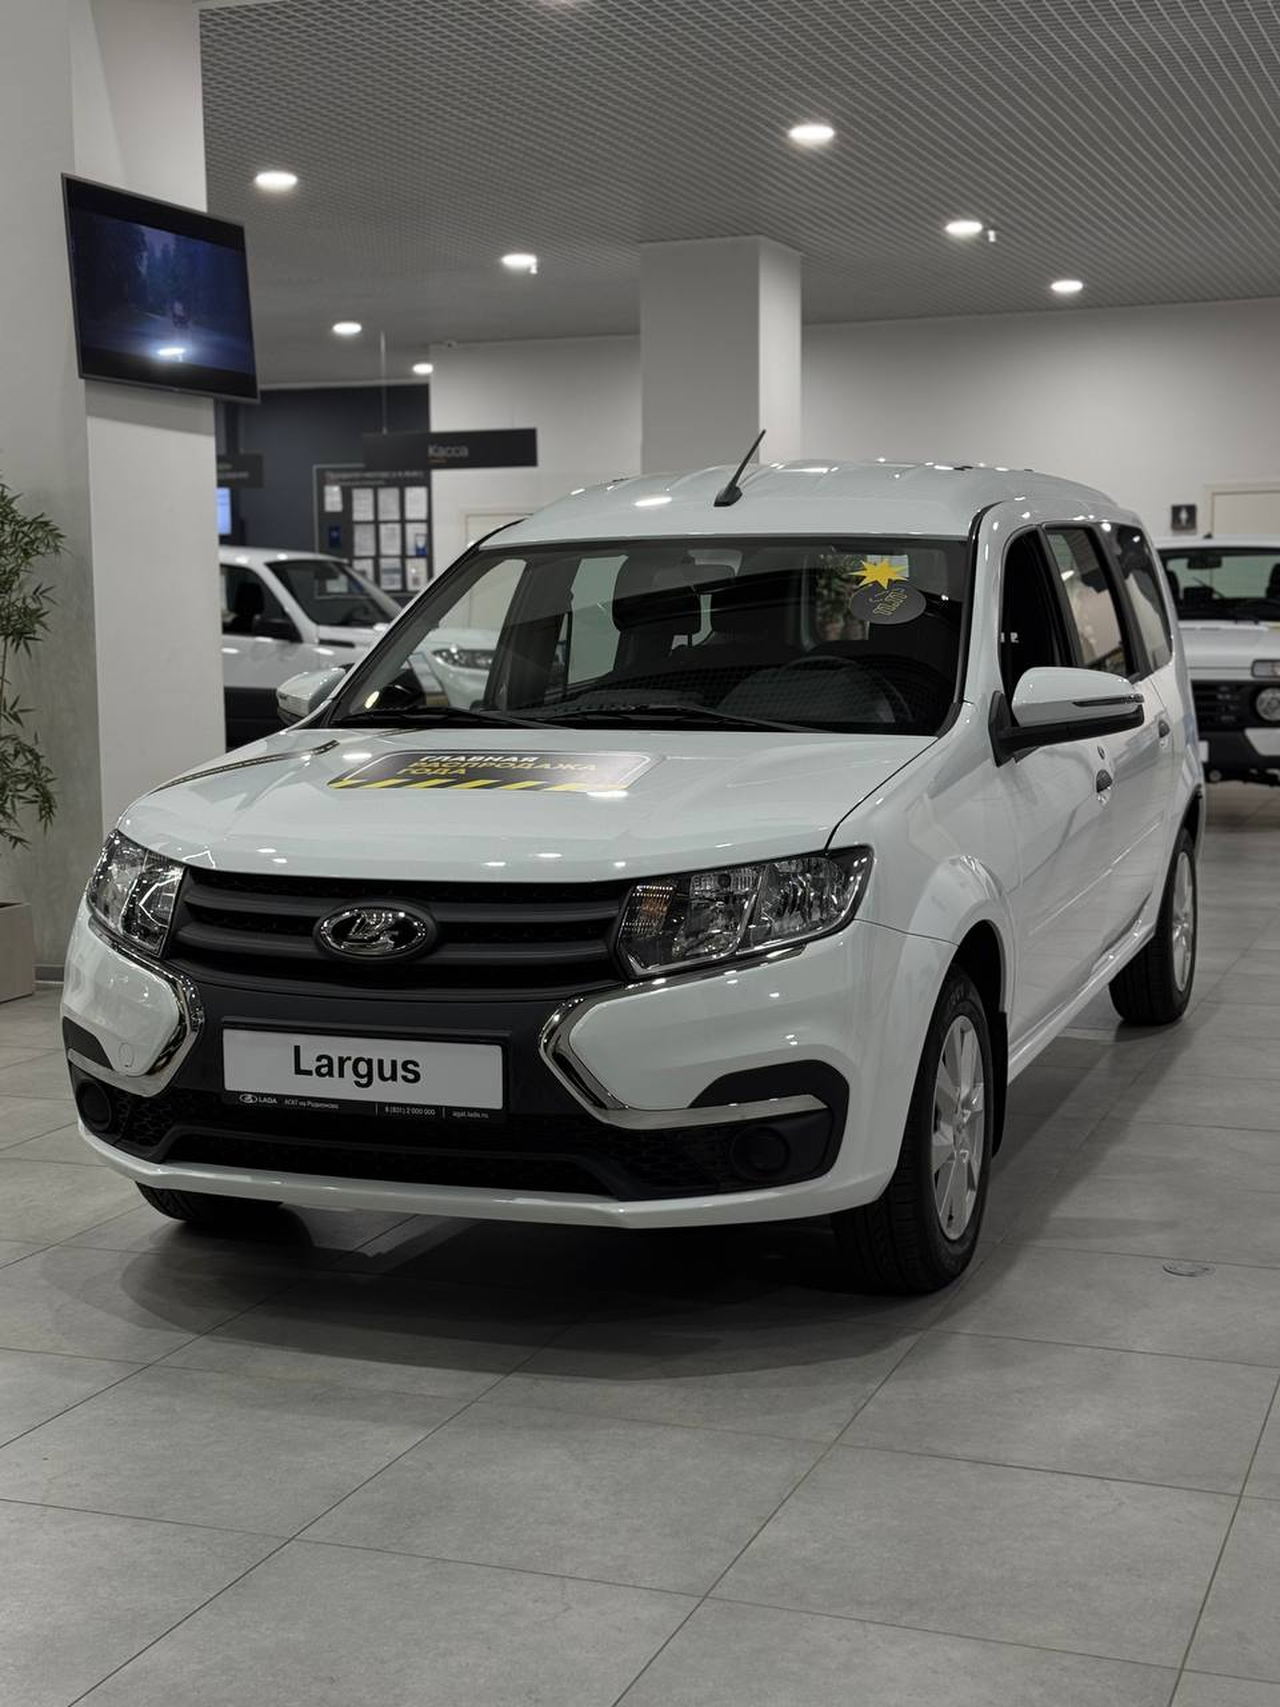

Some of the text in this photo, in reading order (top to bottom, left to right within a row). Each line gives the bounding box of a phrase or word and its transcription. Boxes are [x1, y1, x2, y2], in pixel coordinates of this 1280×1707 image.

[428, 445, 469, 457] Касса
[293, 1045, 421, 1088] Largus
[258, 1096, 278, 1104] LADA
[424, 1108, 436, 1116] 000
